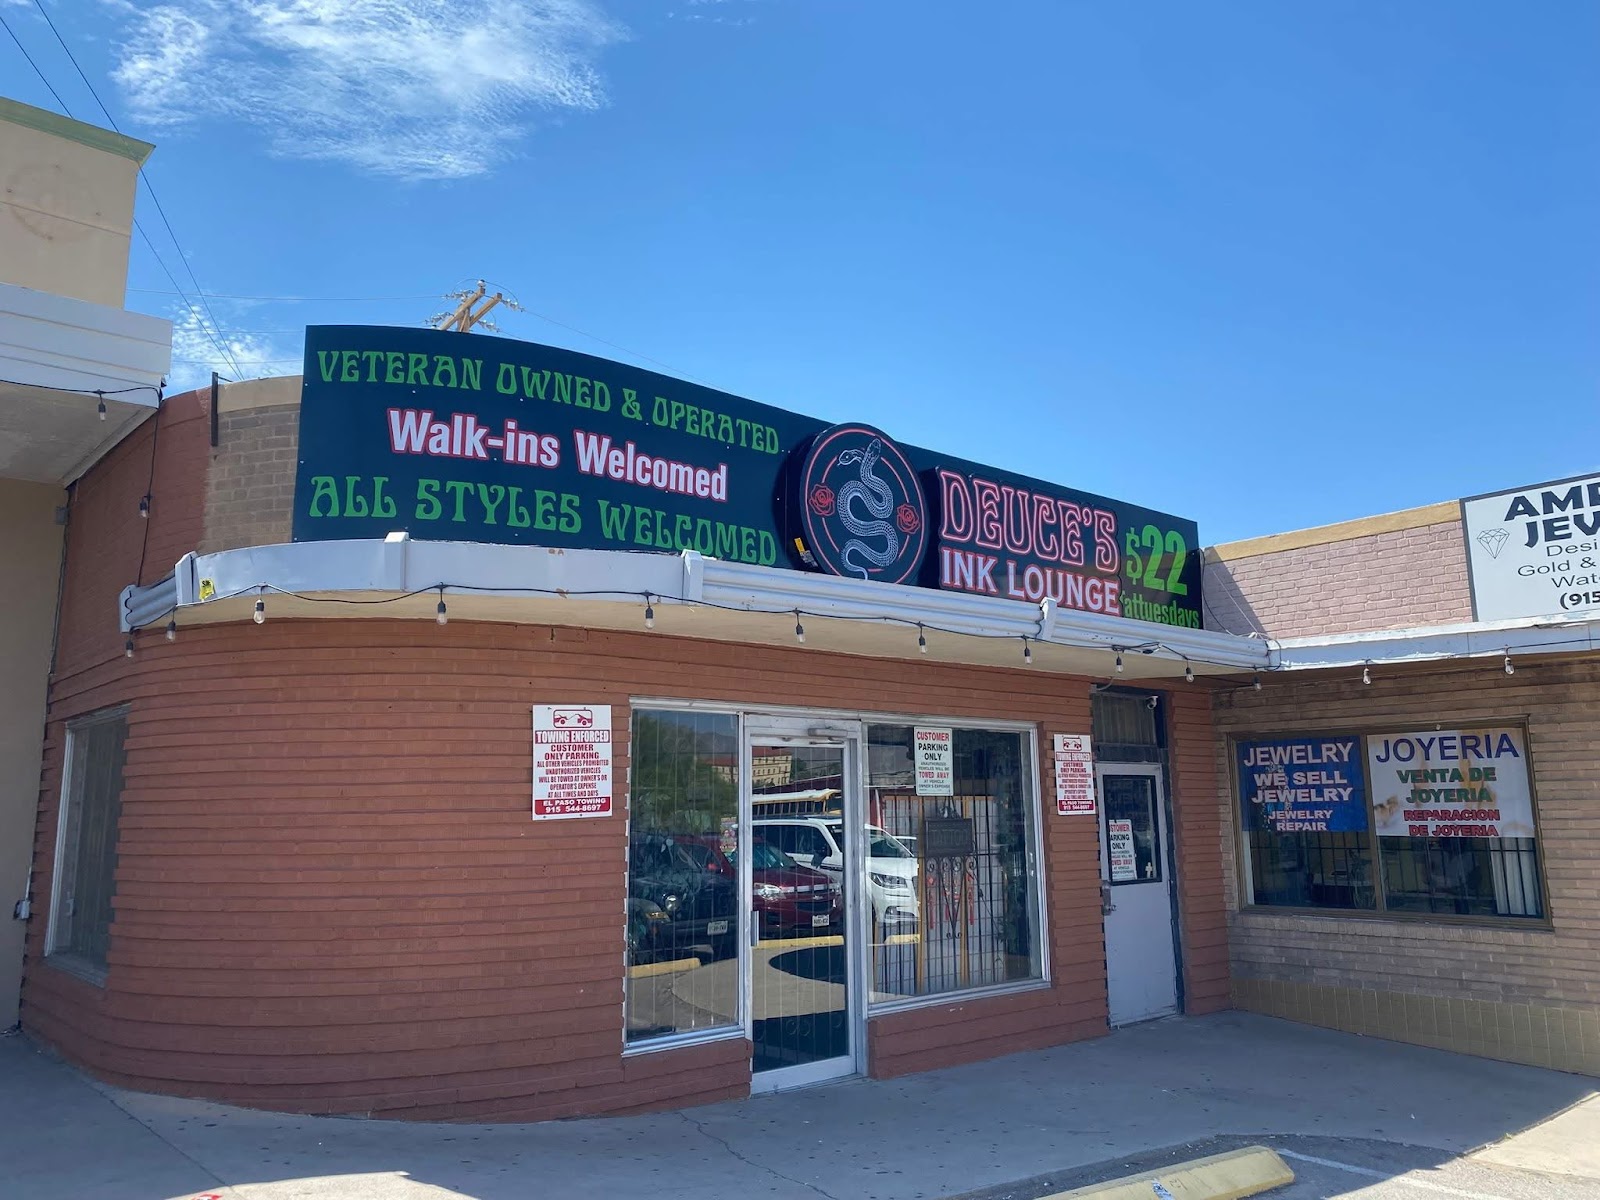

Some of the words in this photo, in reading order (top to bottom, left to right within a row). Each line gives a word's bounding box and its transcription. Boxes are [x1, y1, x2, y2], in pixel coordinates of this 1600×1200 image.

[317, 350, 483, 390] VETERAN
[496, 363, 611, 412] OWNED
[621, 388, 643, 421] &
[652, 396, 779, 455] OPERATED
[387, 408, 560, 469] Walk-ins
[573, 430, 728, 501] Welcomed
[309, 476, 397, 518] ALL
[415, 478, 582, 534] STYLES
[599, 499, 777, 566] WELCOMED
[938, 469, 1119, 575] DEUCE'S
[1126, 524, 1188, 596] $22
[1517, 560, 1570, 577] Gold
[1580, 556, 1597, 569] &
[941, 547, 998, 594] INK
[1006, 560, 1121, 616] LOUNGE
[536, 731, 570, 743] TOWING
[571, 730, 609, 743] ENFORCED
[916, 732, 949, 741] CUSTOMER
[550, 744, 594, 752] CUSTOMER
[918, 743, 948, 751] PARKING
[1244, 742, 1353, 767] JEWELRY
[1375, 733, 1520, 763] JOYERIA
[545, 752, 563, 760] ONLY
[565, 752, 600, 760] PARKING
[924, 752, 942, 760] ONLY
[1253, 772, 1287, 786] WE
[1293, 770, 1347, 785] SELL
[1396, 769, 1464, 784] VENTA
[1470, 767, 1497, 781] DE
[1251, 787, 1353, 803] JEWELRY
[1406, 787, 1493, 803] JOYERIA
[565, 804, 601, 812] 544-8697
[1268, 810, 1333, 819] JEWELRY
[1403, 809, 1500, 821] REPARACION
[1276, 822, 1327, 831] REPAIR
[1408, 825, 1427, 837] DE
[1431, 824, 1499, 837] JOYERIA
